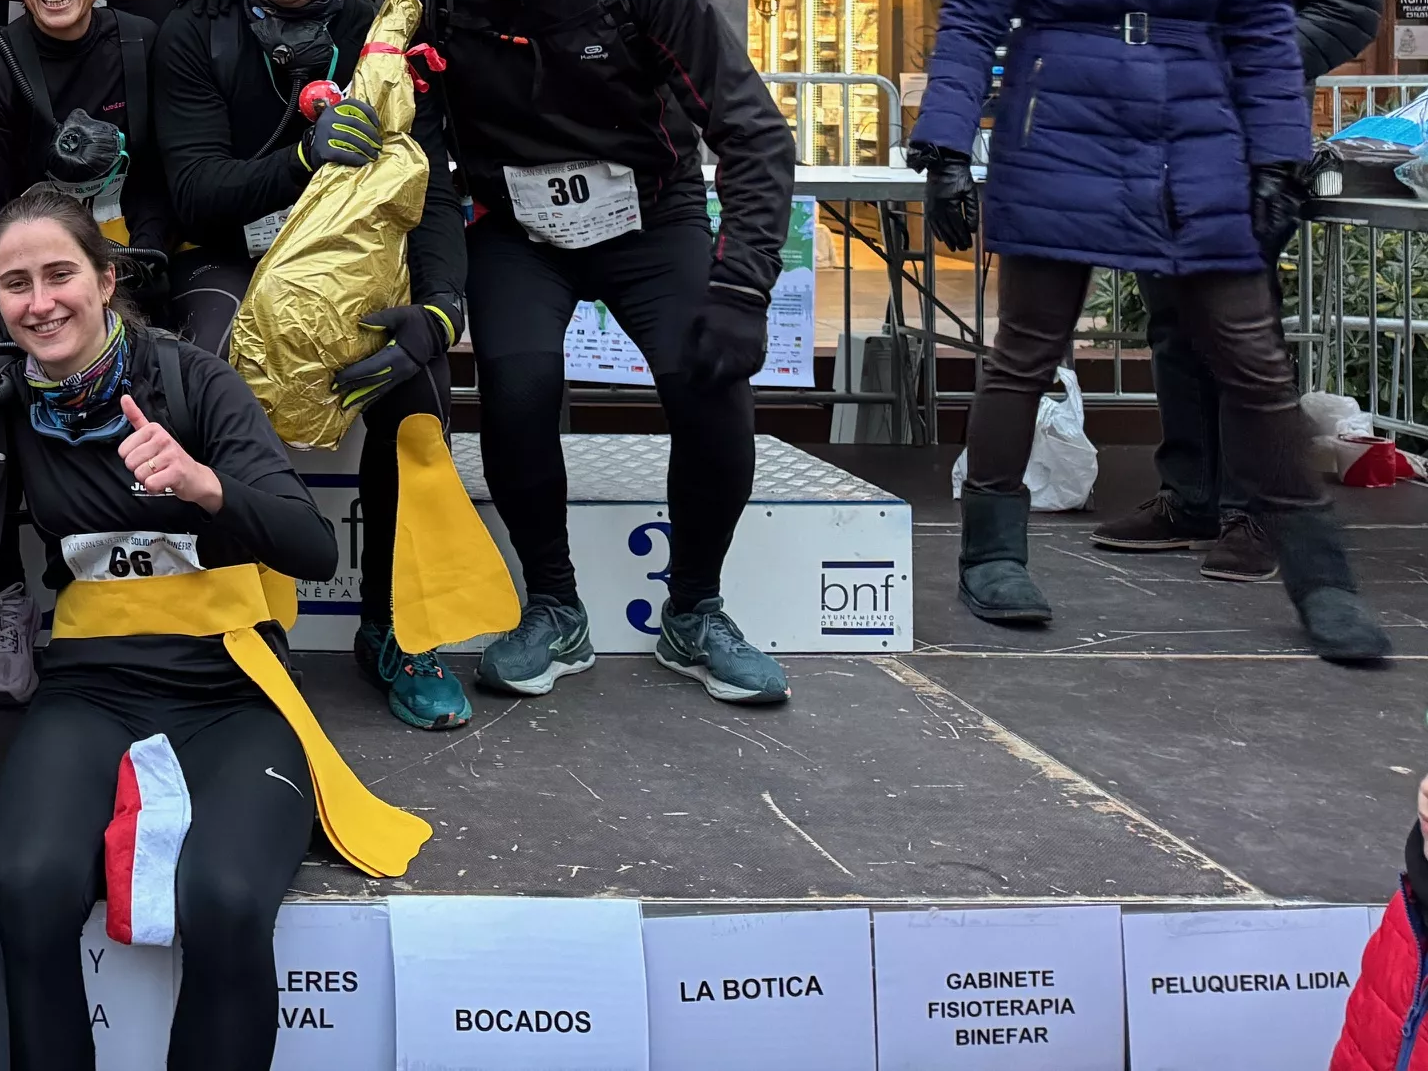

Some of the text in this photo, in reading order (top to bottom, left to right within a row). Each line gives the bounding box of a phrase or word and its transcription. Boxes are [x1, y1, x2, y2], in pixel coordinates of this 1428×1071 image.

[547, 173, 590, 207] 30
[108, 545, 154, 578] 66
[821, 573, 894, 611] bnf
[680, 975, 824, 1003] LA BOTICA
[946, 970, 1055, 990] GABINETE
[1151, 971, 1351, 995] PELUQUERIA LIDIA
[277, 1007, 335, 1029] VAL
[928, 997, 1076, 1020] FISIOTERAPIA
[455, 1009, 592, 1034] BOCADOS
[955, 1026, 1049, 1047] BINEFAR
